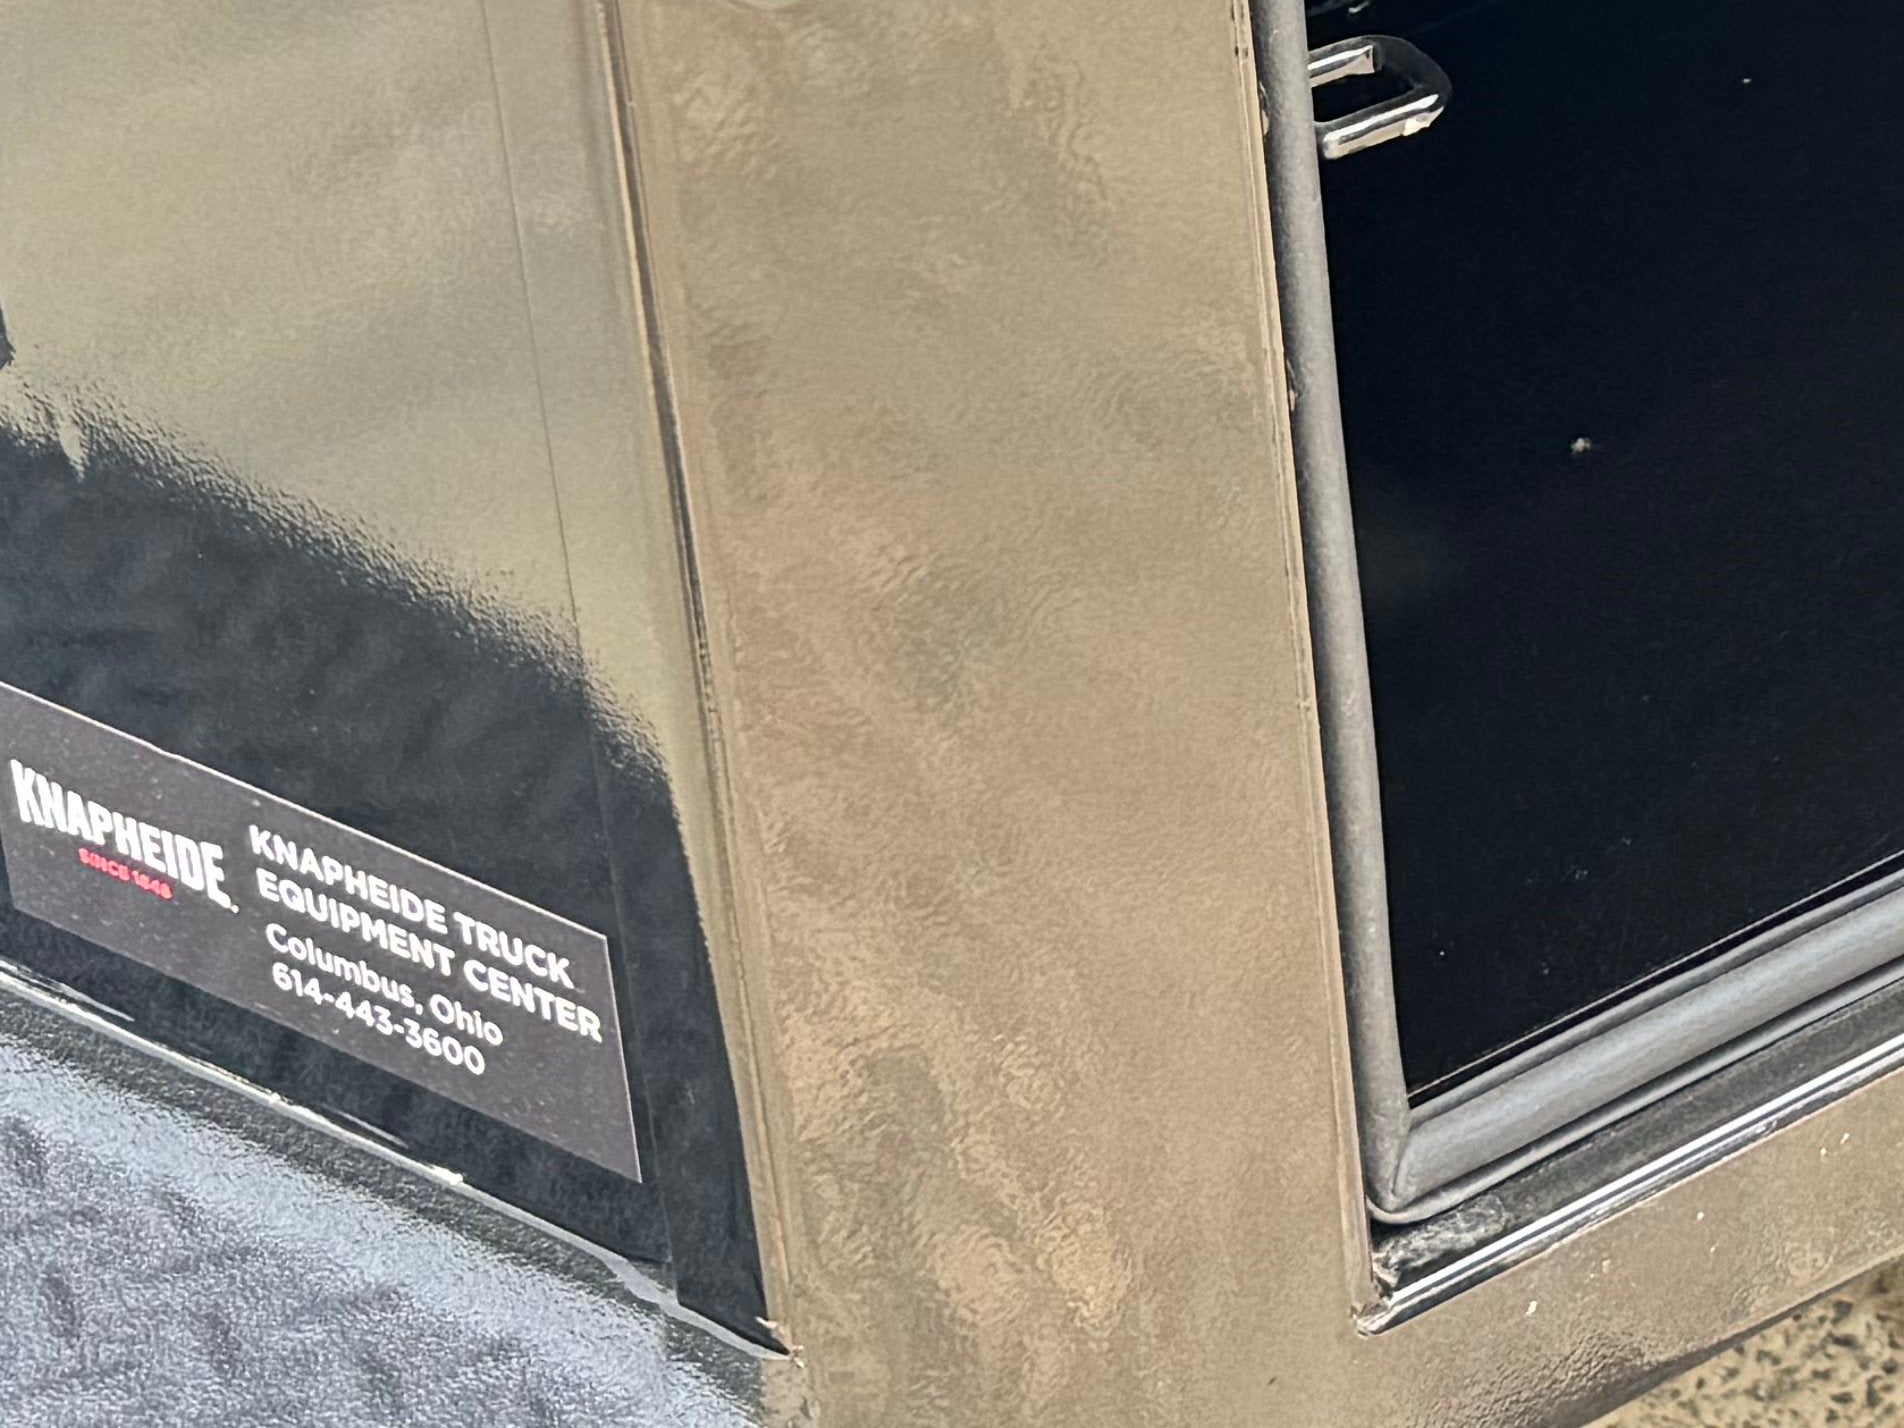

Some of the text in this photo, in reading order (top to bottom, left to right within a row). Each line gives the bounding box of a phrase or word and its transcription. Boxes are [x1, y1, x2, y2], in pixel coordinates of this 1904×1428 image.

[10, 758, 233, 911] KNAPHEIDE
[249, 824, 574, 988] KNAPHEIDE TRUCK
[256, 870, 602, 1044] EQUIPMENT CENTER
[265, 923, 505, 1046] Columbus, Ohio
[273, 965, 486, 1077] 614-443-3600
